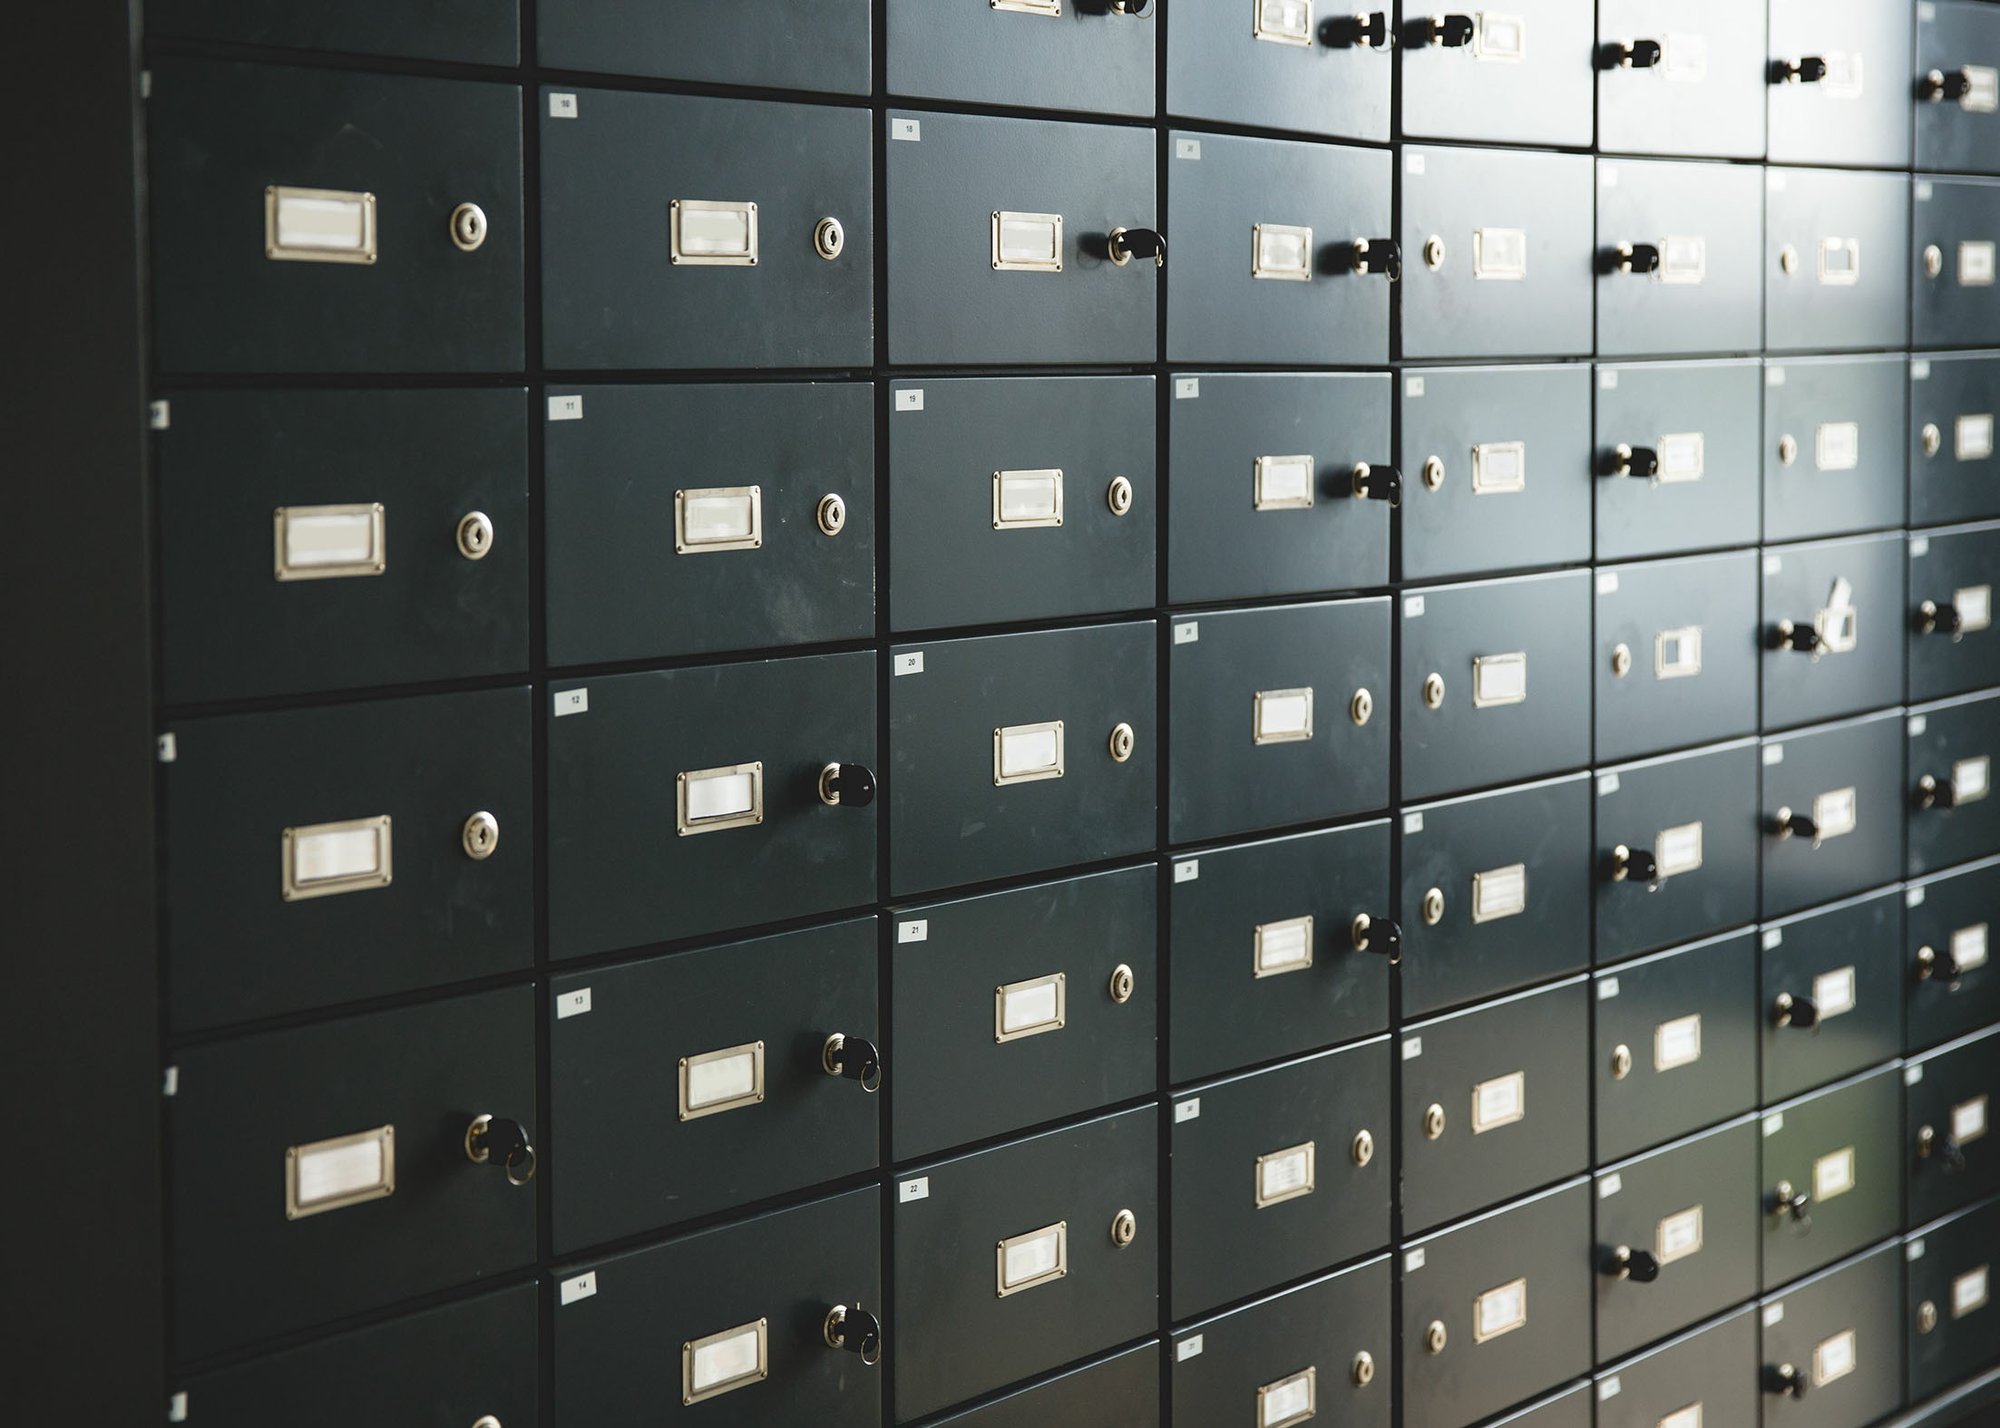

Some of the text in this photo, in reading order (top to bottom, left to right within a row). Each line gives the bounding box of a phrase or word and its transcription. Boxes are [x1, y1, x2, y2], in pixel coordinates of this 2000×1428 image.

[908, 658, 916, 667] 20
[571, 695, 580, 704] 12
[911, 926, 919, 934] 21
[574, 996, 584, 1005] 13
[909, 1184, 918, 1193] 22
[578, 1281, 587, 1290] 14
